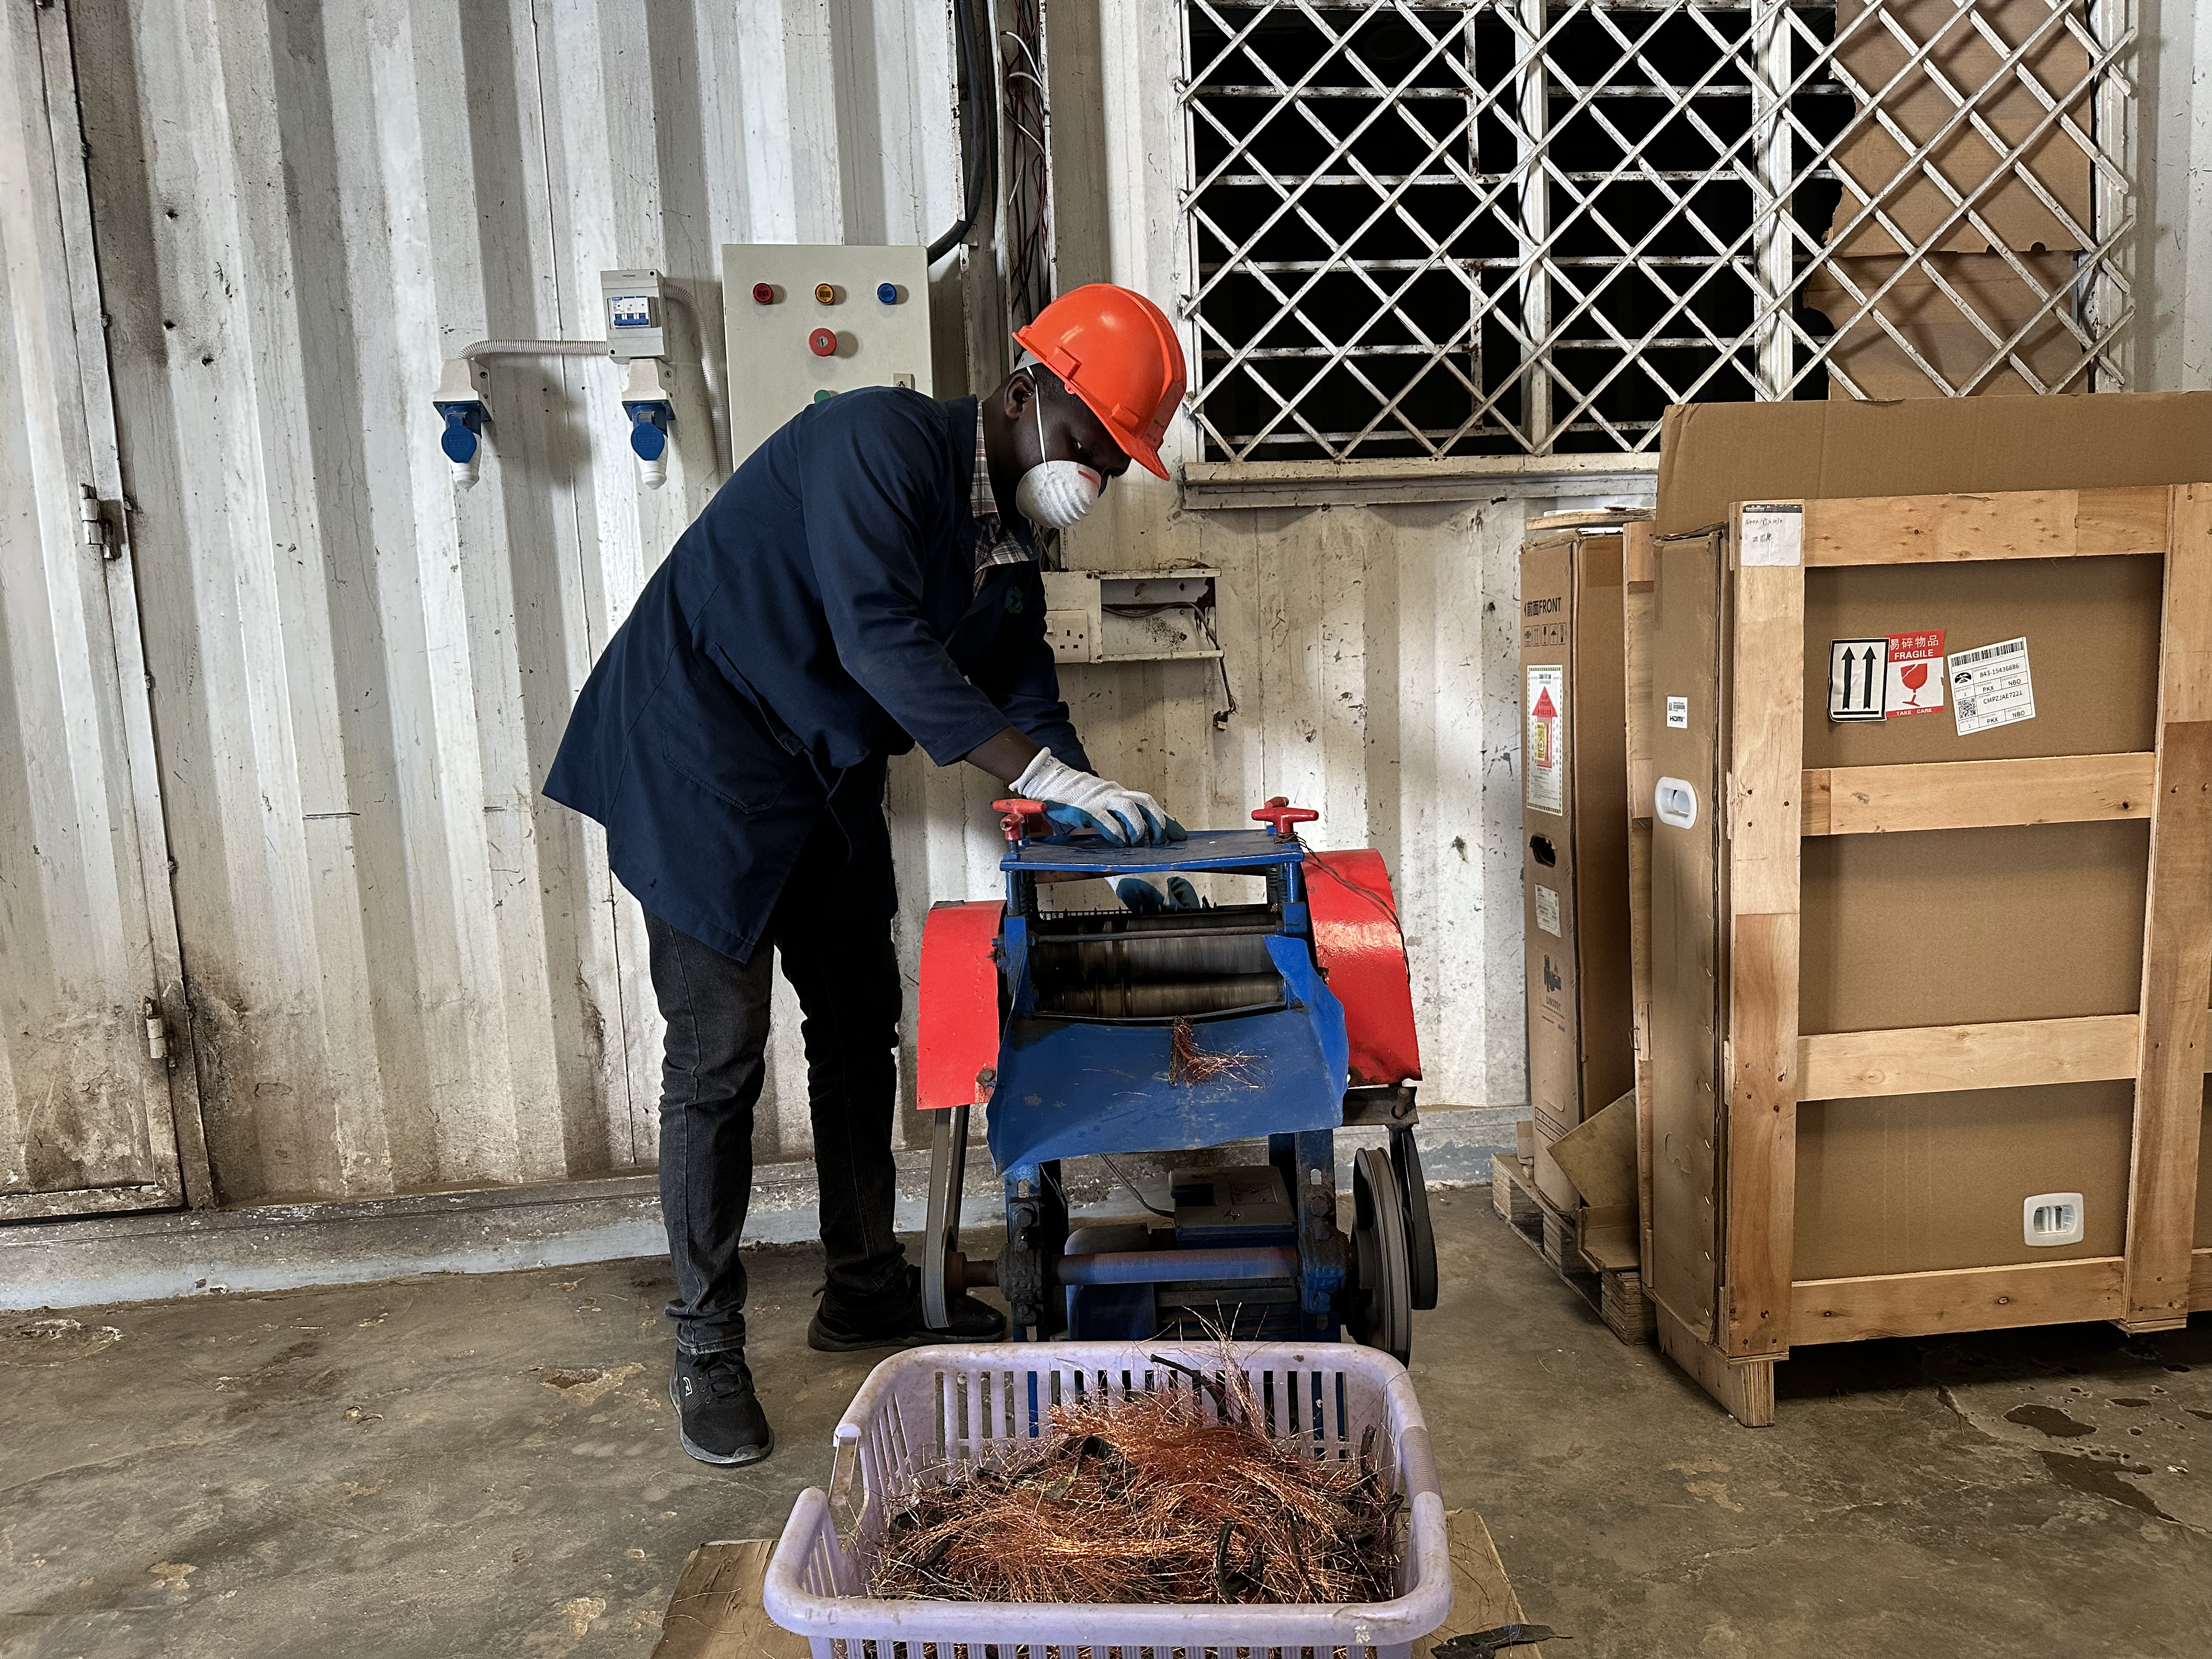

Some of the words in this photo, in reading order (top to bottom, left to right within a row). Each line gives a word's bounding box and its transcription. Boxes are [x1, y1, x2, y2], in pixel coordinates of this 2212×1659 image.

[1539, 597, 1561, 614] FRONT
[1890, 635, 1939, 651] 易碎物品
[1894, 648, 1933, 660] FRAGILE
[2012, 710, 2025, 718] NBO
